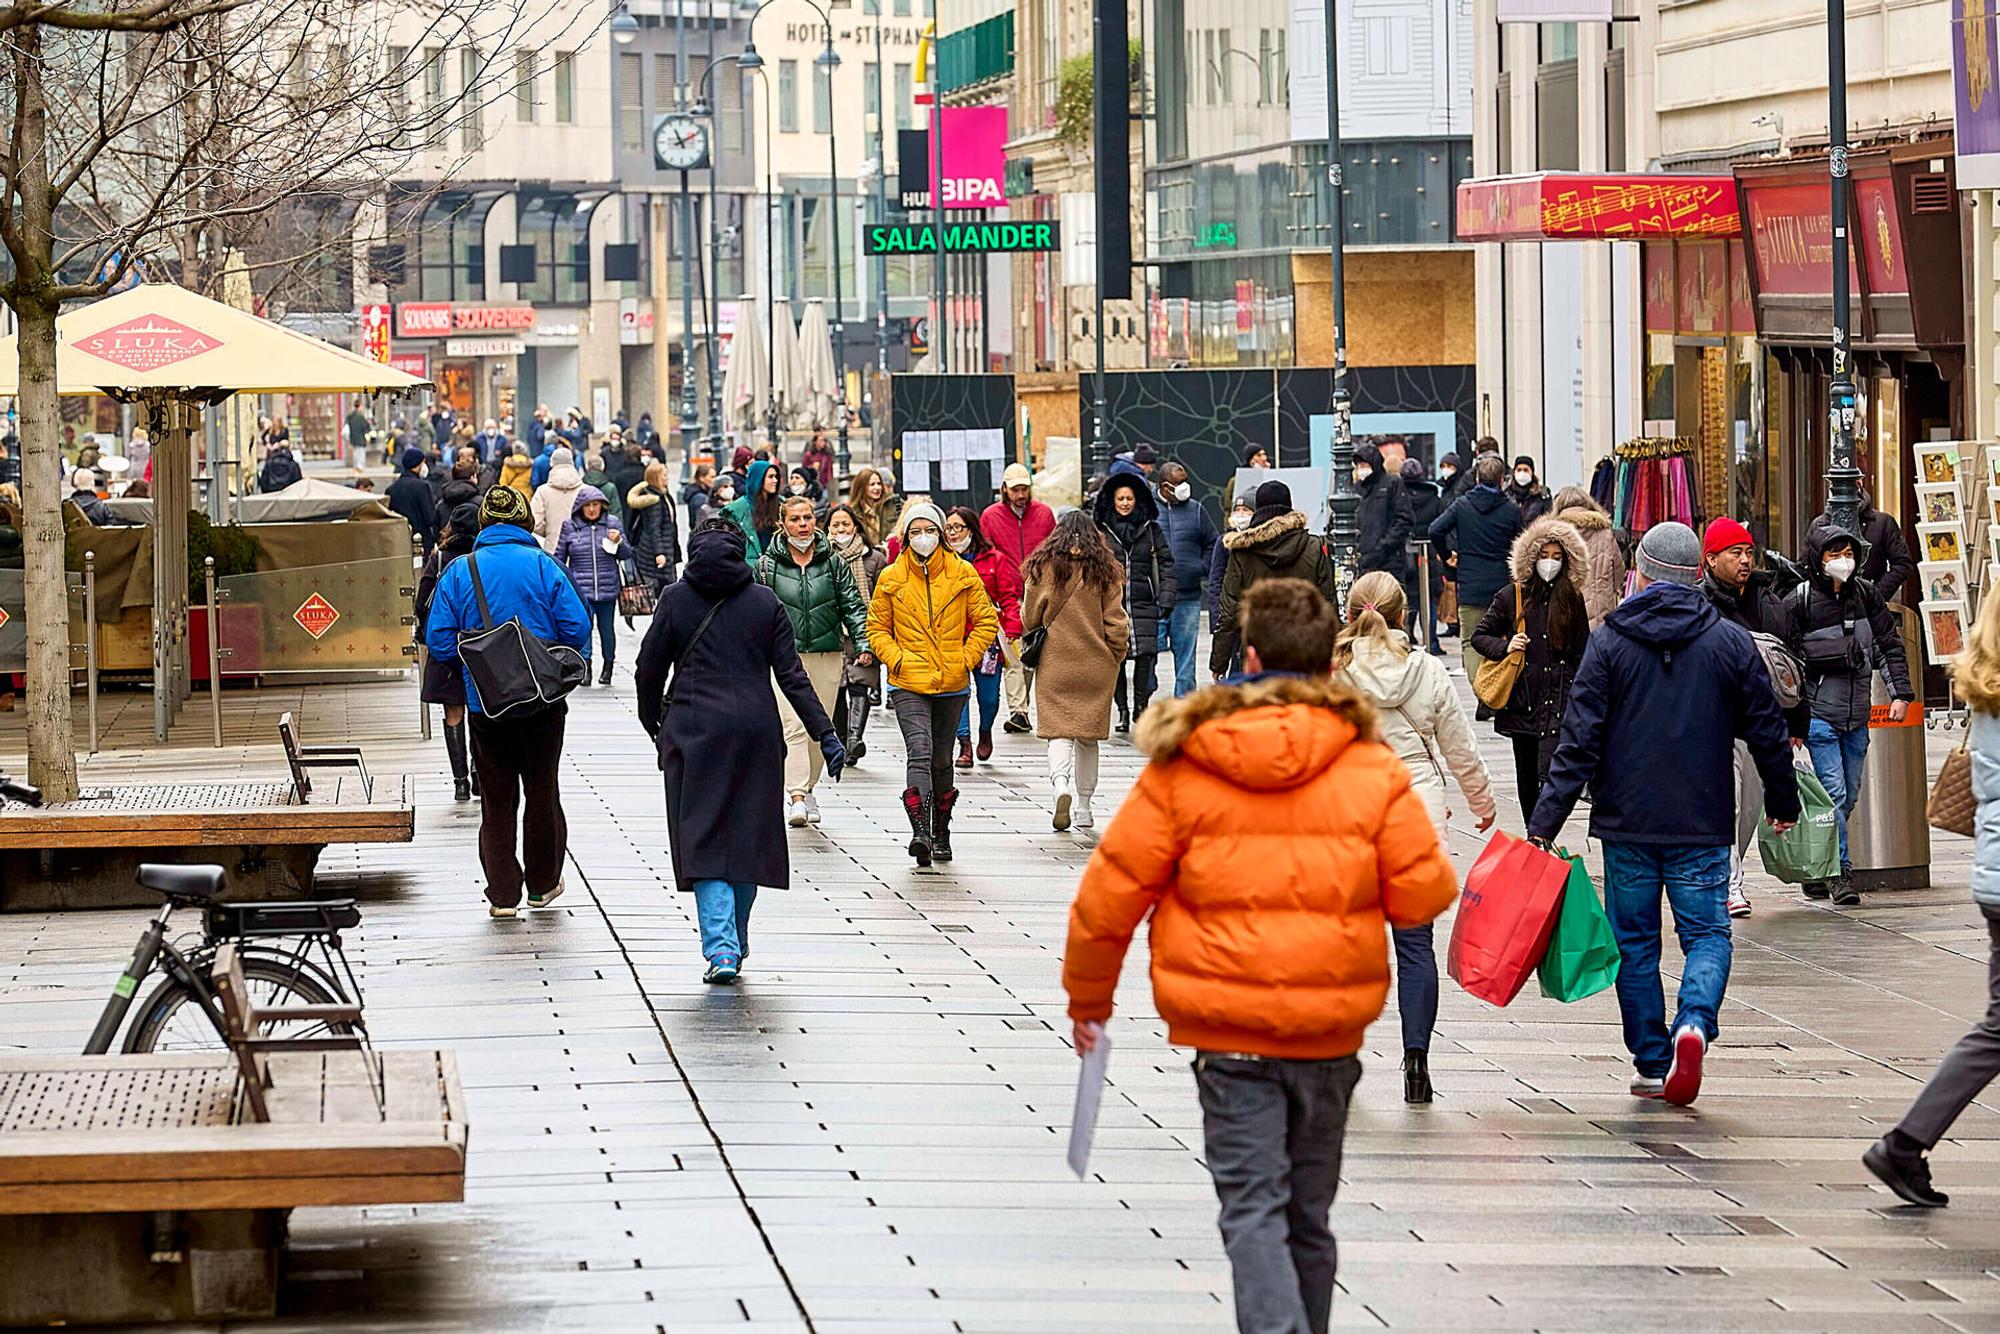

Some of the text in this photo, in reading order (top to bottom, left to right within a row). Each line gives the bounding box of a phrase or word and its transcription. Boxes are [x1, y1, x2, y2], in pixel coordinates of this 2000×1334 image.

[856, 26, 923, 45] STPHAN
[942, 178, 1002, 201] BIPA
[872, 224, 1051, 253] SALAMANDER
[1767, 216, 1808, 272] SLUKA
[404, 309, 450, 330] SOUVENIRS
[90, 338, 209, 350] SLUKA
